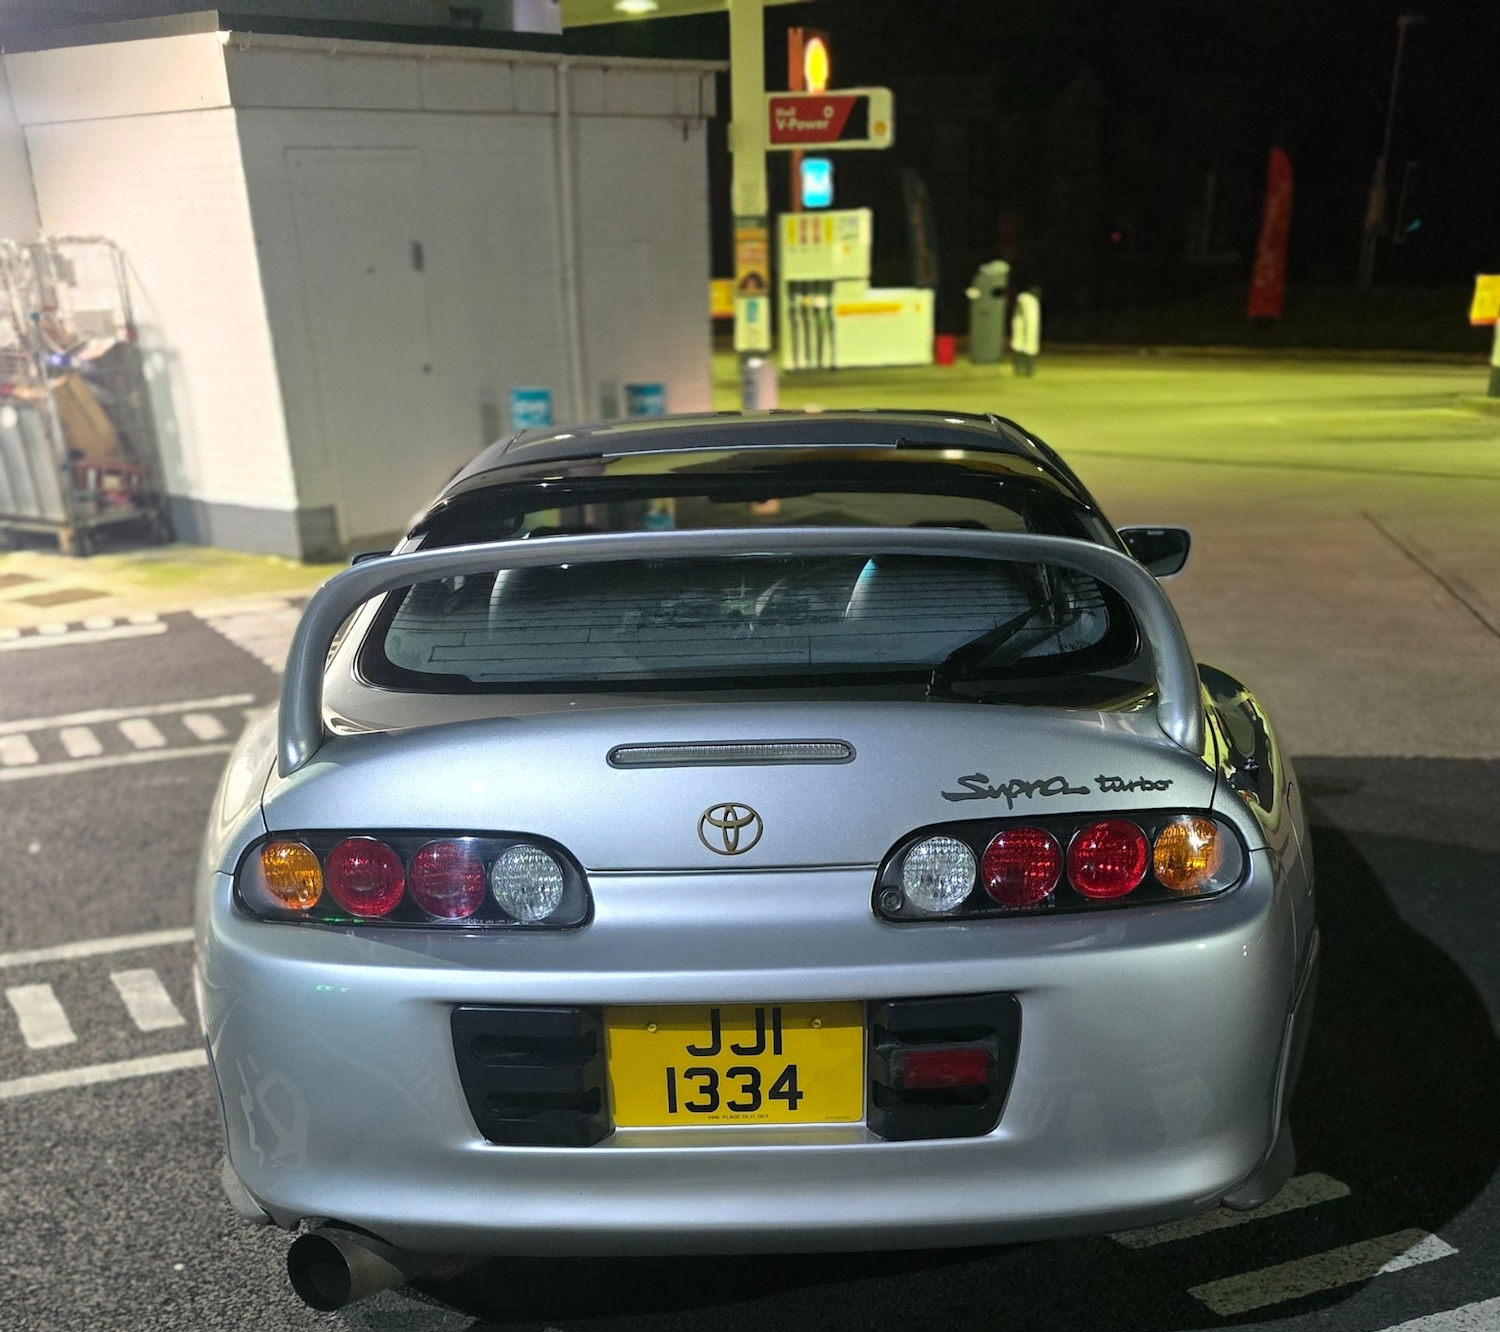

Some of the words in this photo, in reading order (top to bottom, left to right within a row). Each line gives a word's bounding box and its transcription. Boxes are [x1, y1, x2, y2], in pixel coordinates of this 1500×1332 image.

[775, 118, 829, 131] V-Power
[941, 773, 1091, 810] Supra
[1094, 774, 1174, 793] turbo
[666, 1064, 804, 1113] 1334
